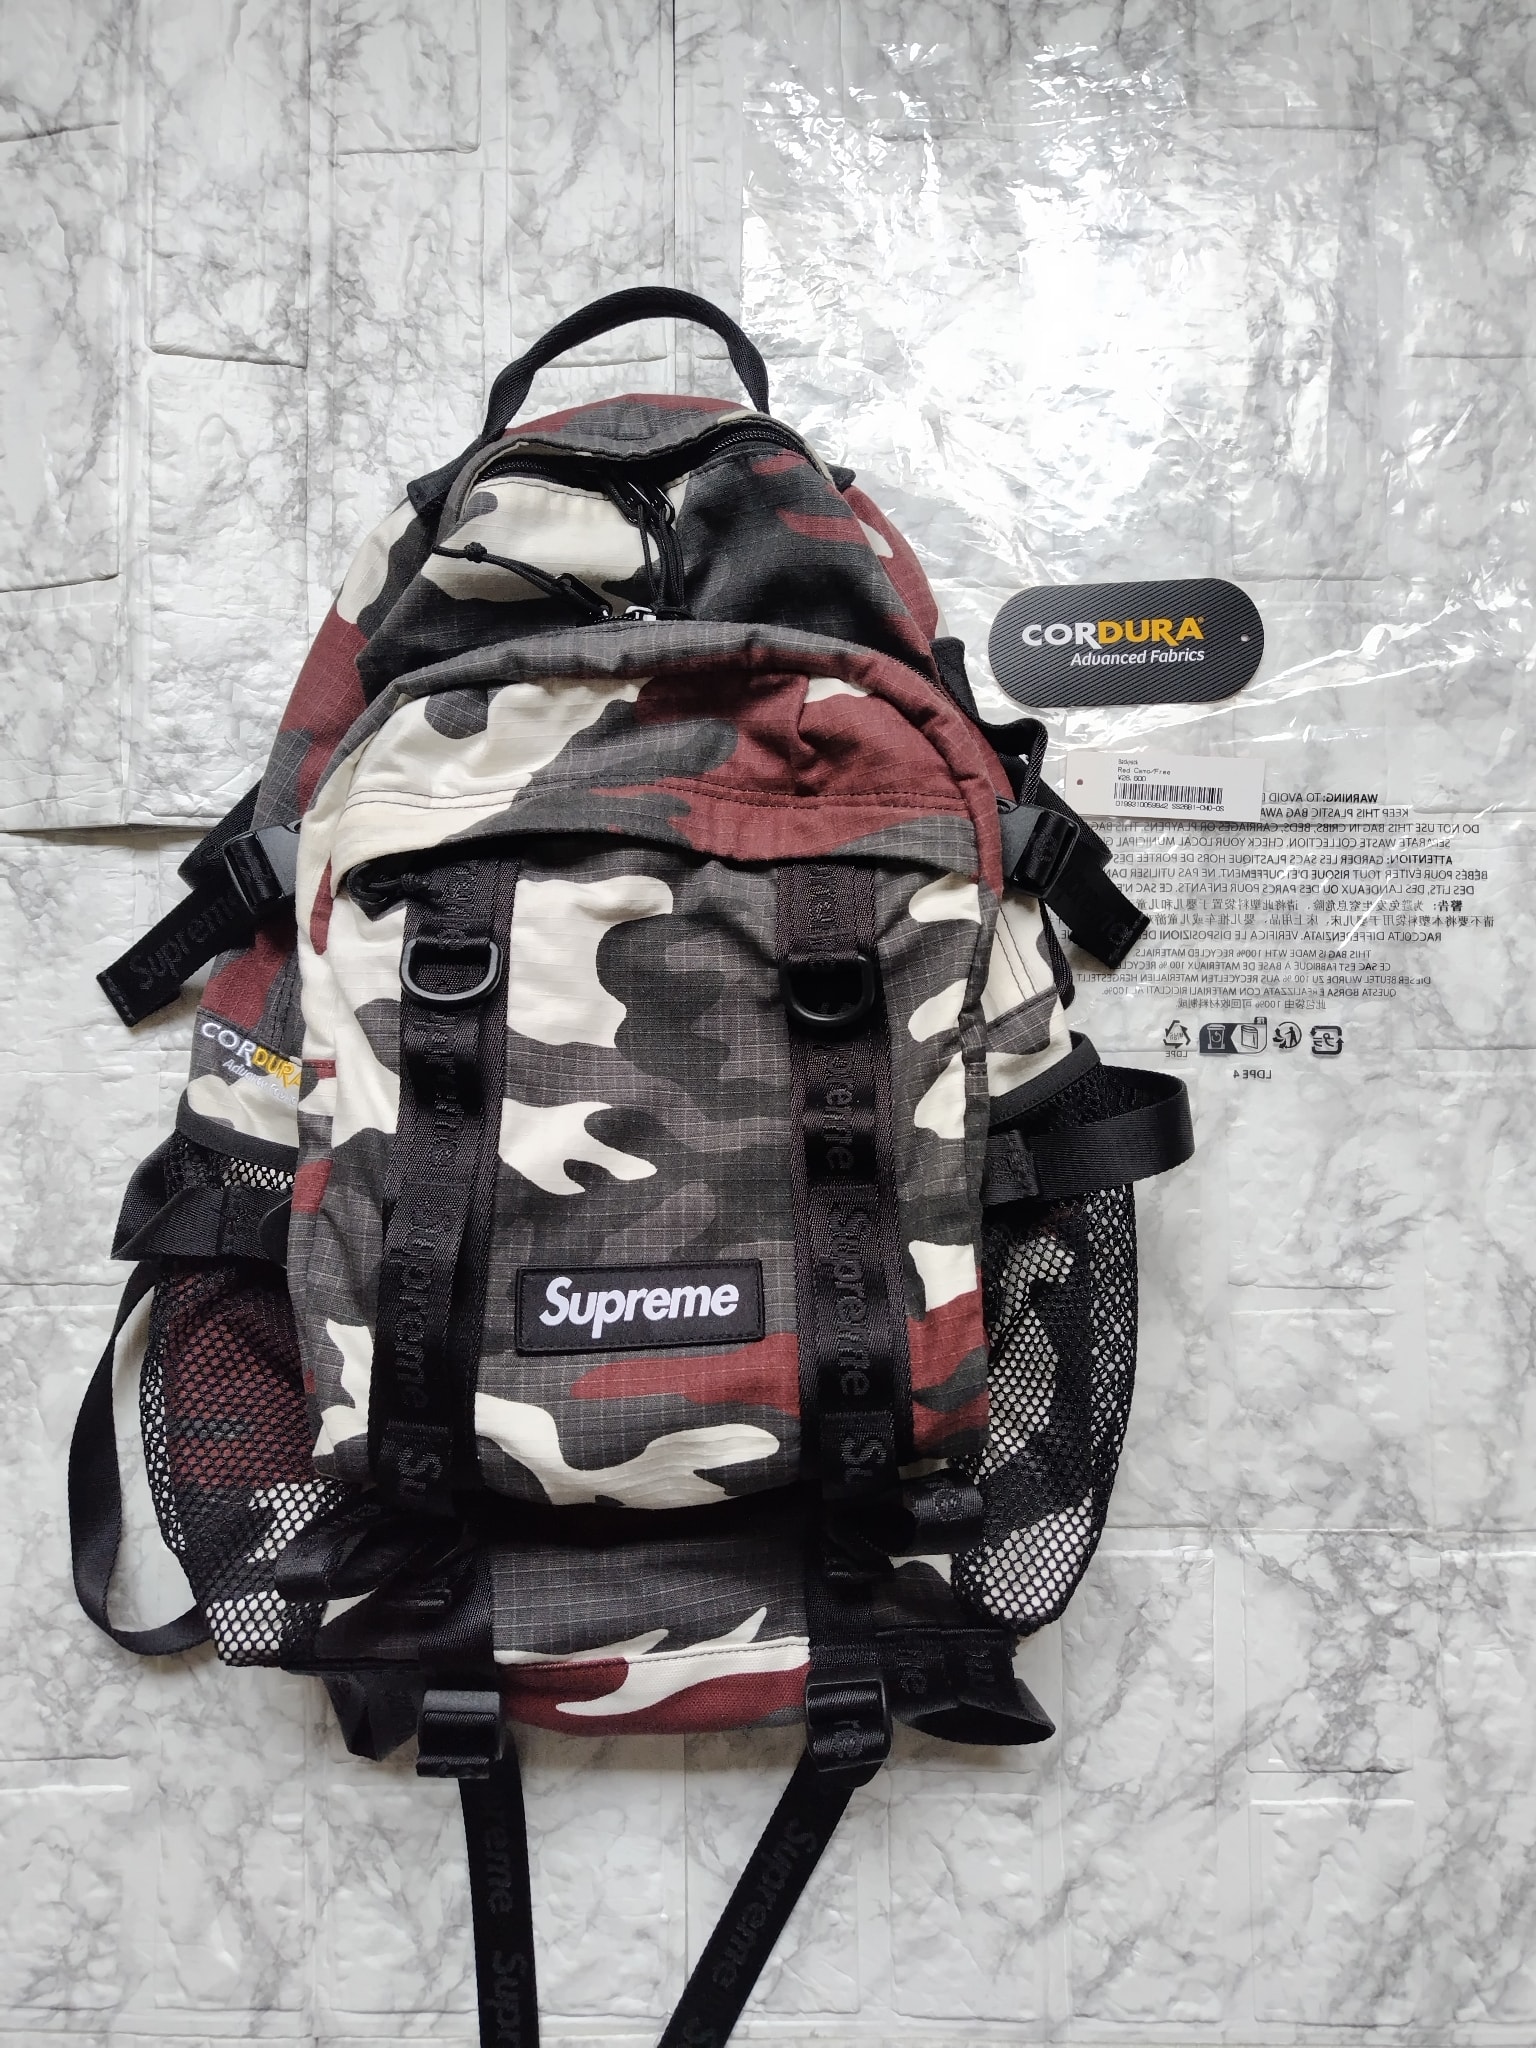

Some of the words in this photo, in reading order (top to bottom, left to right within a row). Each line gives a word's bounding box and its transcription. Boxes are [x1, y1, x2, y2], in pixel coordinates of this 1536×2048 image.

[1071, 649, 1146, 667] Advanced
[1151, 647, 1205, 665] Fabrics
[1117, 766, 1131, 774] Red
[129, 896, 238, 991] Suprem
[539, 1276, 739, 1339] Supreme
[820, 1202, 873, 1399] Supreme
[712, 1818, 818, 1992] Supreme
[485, 1949, 528, 2043] Supr
